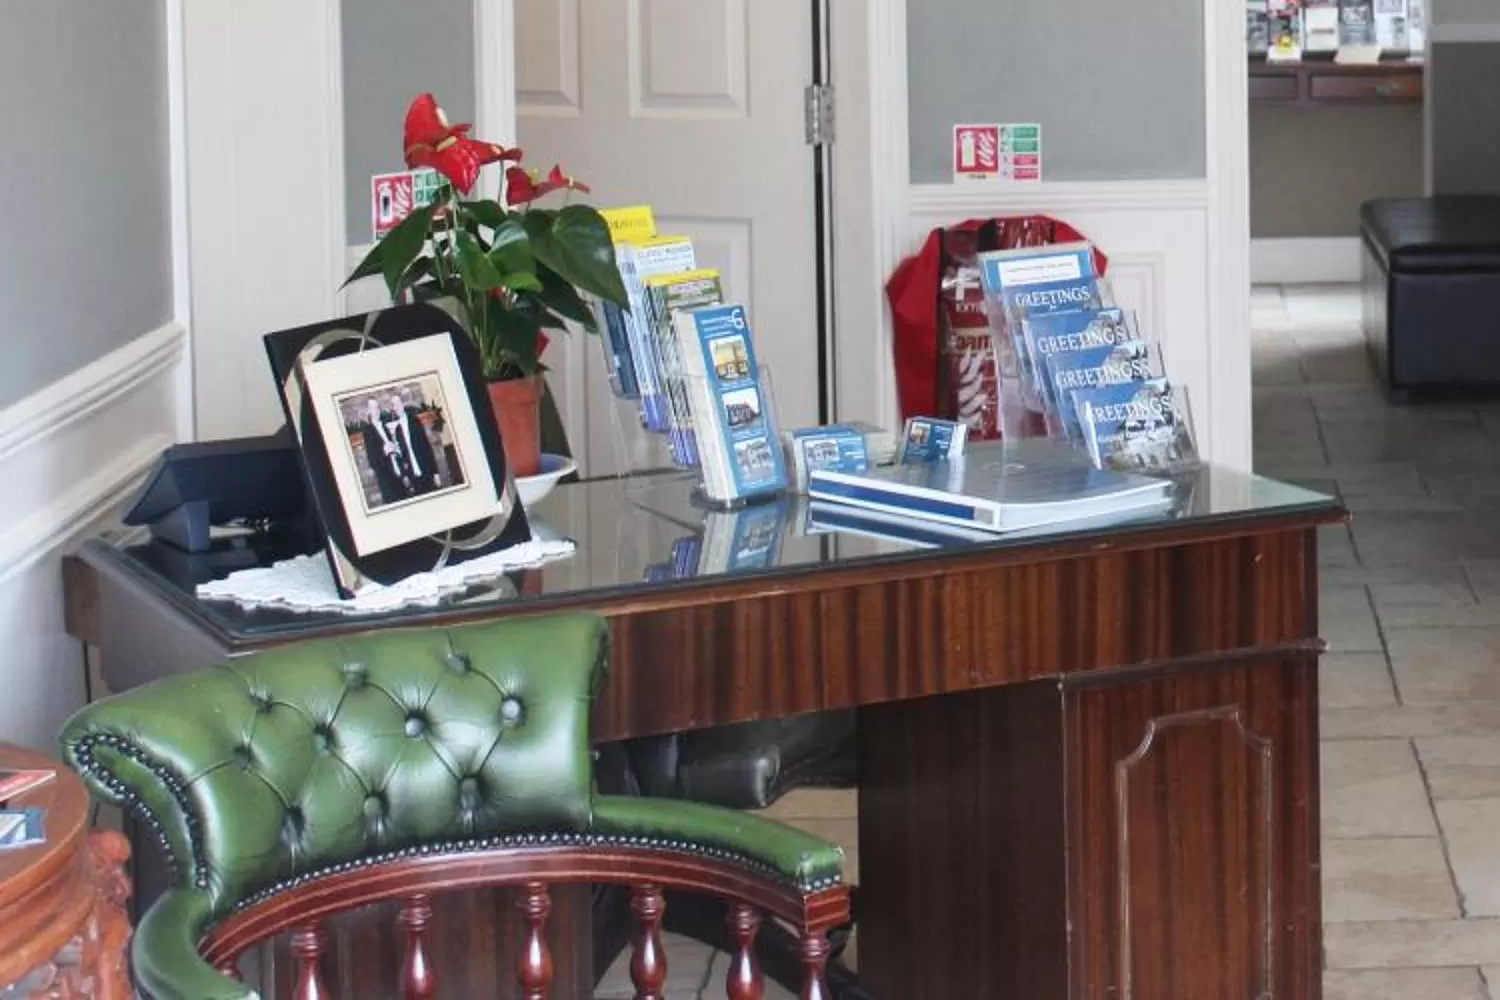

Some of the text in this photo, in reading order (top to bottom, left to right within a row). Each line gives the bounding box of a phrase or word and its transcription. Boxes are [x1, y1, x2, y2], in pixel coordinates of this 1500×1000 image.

[1015, 285, 1091, 307] GREETINGS
[1038, 326, 1126, 354] GREETINGS
[1056, 359, 1143, 389] GREETINGS
[1088, 396, 1172, 423] REETINGS
